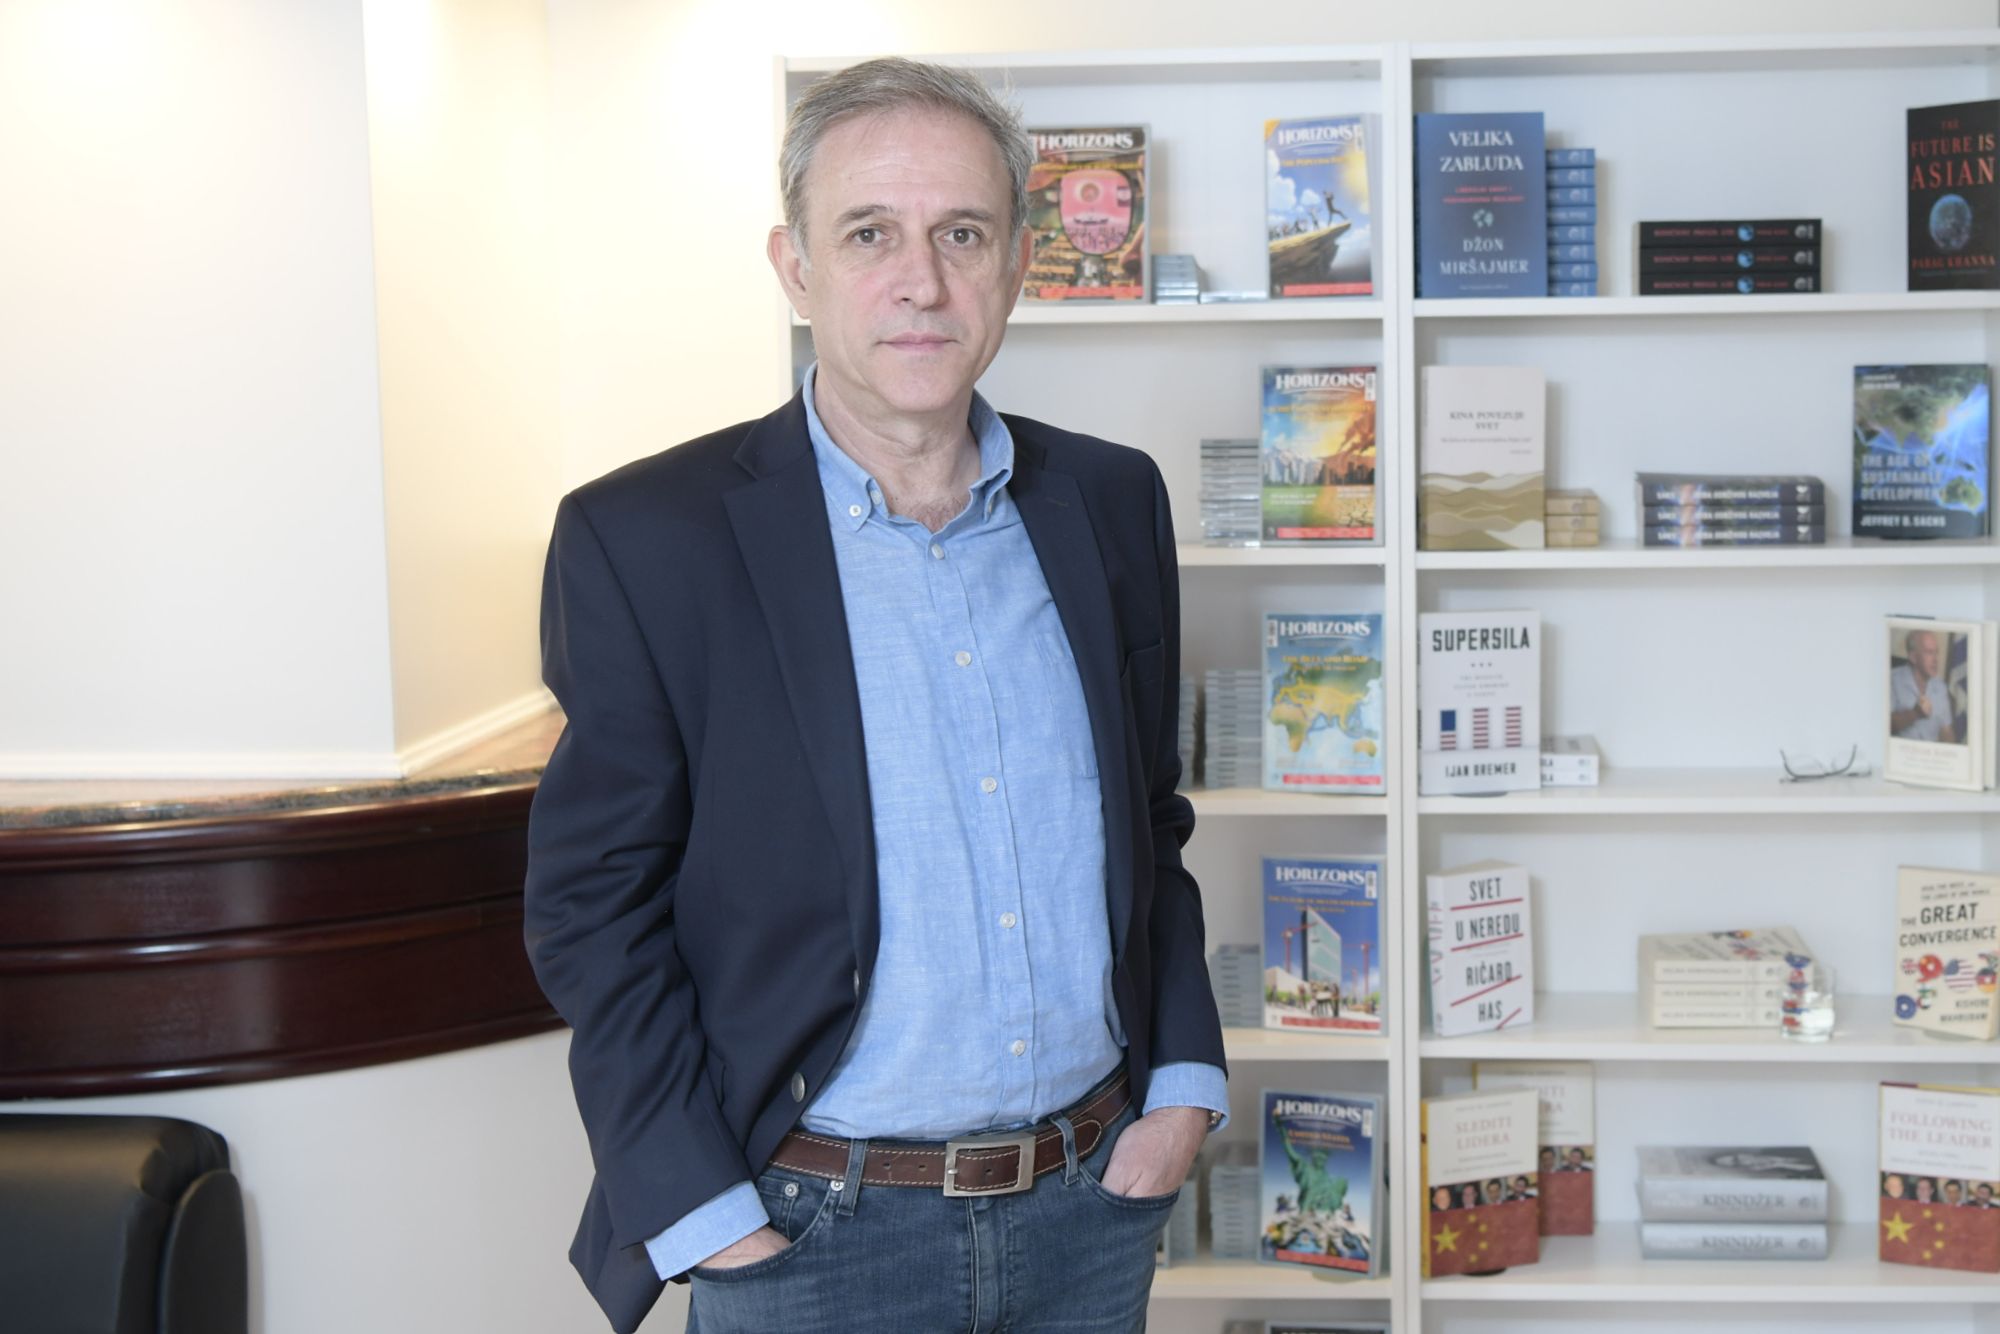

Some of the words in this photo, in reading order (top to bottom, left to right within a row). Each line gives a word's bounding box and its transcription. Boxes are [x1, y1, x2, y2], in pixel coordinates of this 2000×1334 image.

[1039, 132, 1134, 150] HORIZONS
[1278, 126, 1353, 145] HORIZONS
[1449, 130, 1514, 147] VELIKA
[1911, 136, 1972, 159] FUTURE
[1978, 133, 1995, 152] IS
[1440, 155, 1524, 172] ZABLUDA
[1911, 157, 1995, 190] ASIAN
[1463, 237, 1504, 252] DŽON
[1276, 372, 1364, 390] HORIZONS
[1280, 621, 1371, 636] HORIZONS
[1432, 627, 1530, 652] SUPERSILA
[1473, 762, 1516, 776] BREMER
[1276, 866, 1365, 885] HORIZONS
[1469, 877, 1501, 901] SVET
[1921, 903, 1978, 925] GREAT
[1456, 921, 1464, 941] U
[1470, 913, 1520, 939] NEREDU
[1899, 926, 1997, 947] CONVERGENCE
[1466, 961, 1512, 986] RIČARD
[1478, 1001, 1502, 1022] HAS
[1277, 1099, 1361, 1122] HORIZONS
[1456, 1116, 1512, 1134] SLEDITI
[1891, 1111, 1992, 1132] FOLLOWING
[1457, 1135, 1511, 1151] LIDERA
[1890, 1127, 1921, 1142] THE
[1926, 1131, 1993, 1149] LEADER
